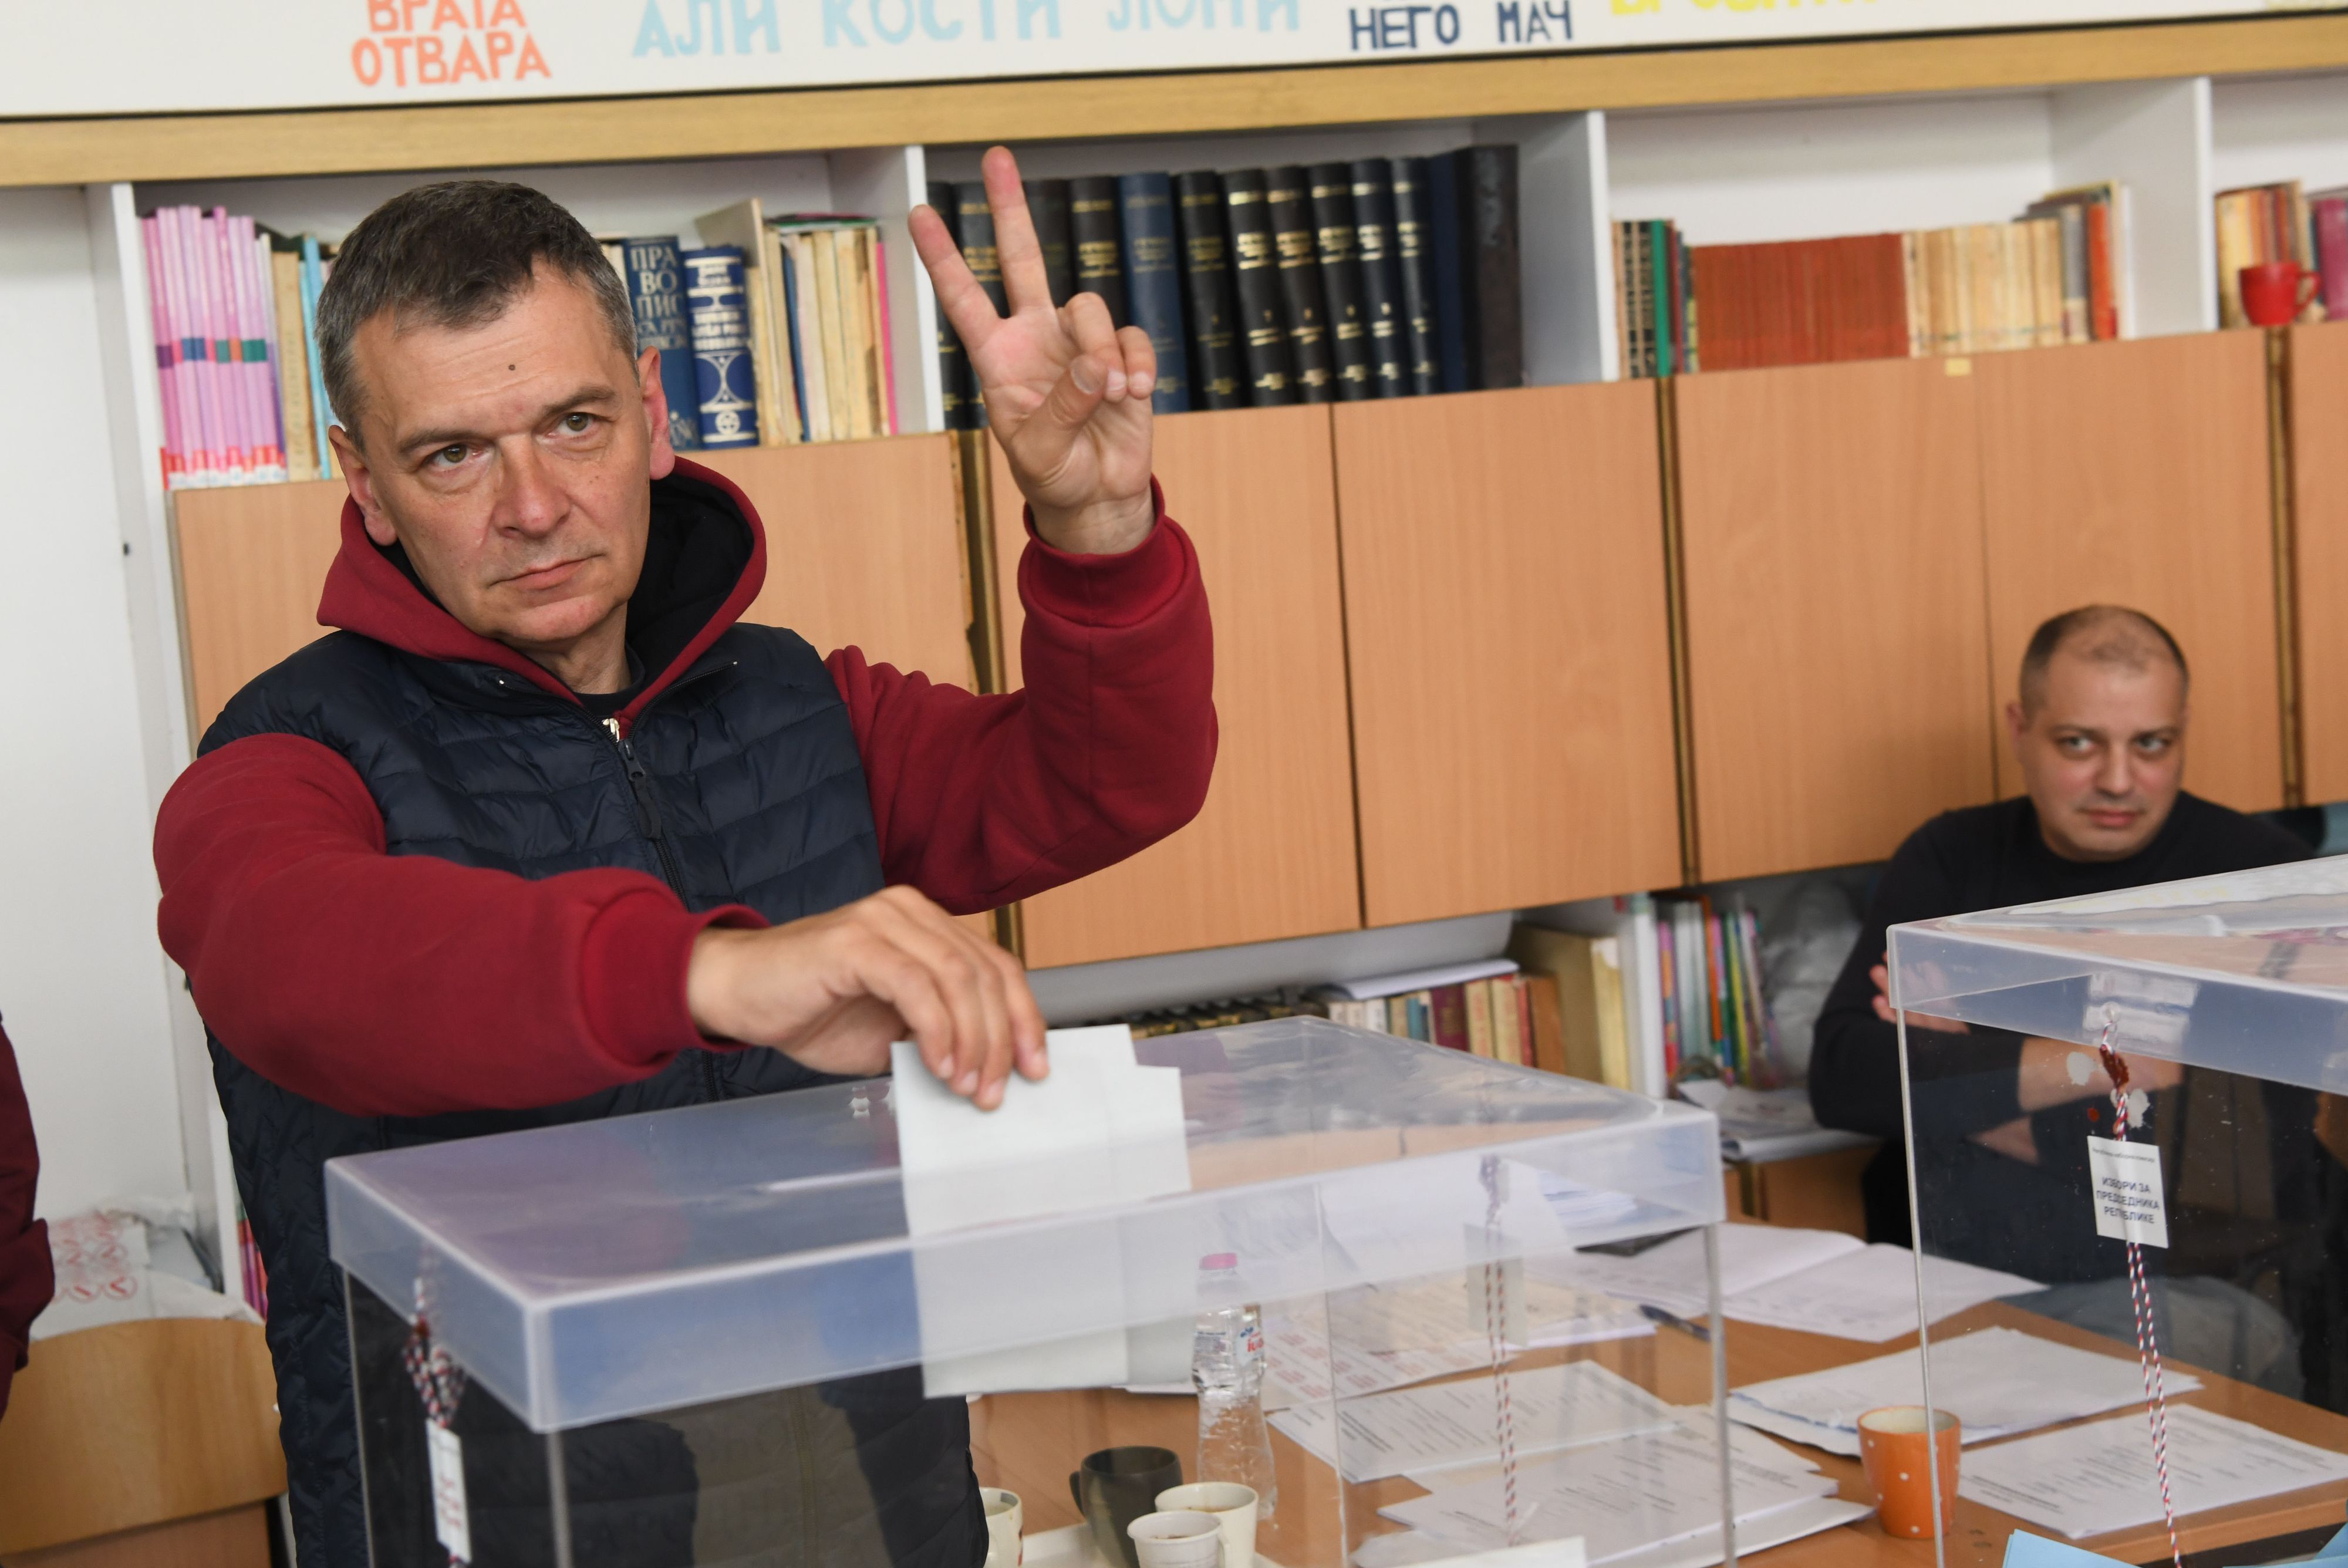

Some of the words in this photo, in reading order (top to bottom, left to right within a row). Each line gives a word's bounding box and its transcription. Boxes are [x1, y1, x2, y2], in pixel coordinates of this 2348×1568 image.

[632, 0, 781, 57] АЛИ
[1349, 5, 1459, 50] НЕГО
[1497, 0, 1572, 43] МАЧ
[352, 31, 552, 86] ОТВАРА
[640, 270, 677, 294] ВО
[2102, 1177, 2137, 1191] ИЗБОРИ
[2138, 1183, 2150, 1193] ЗА
